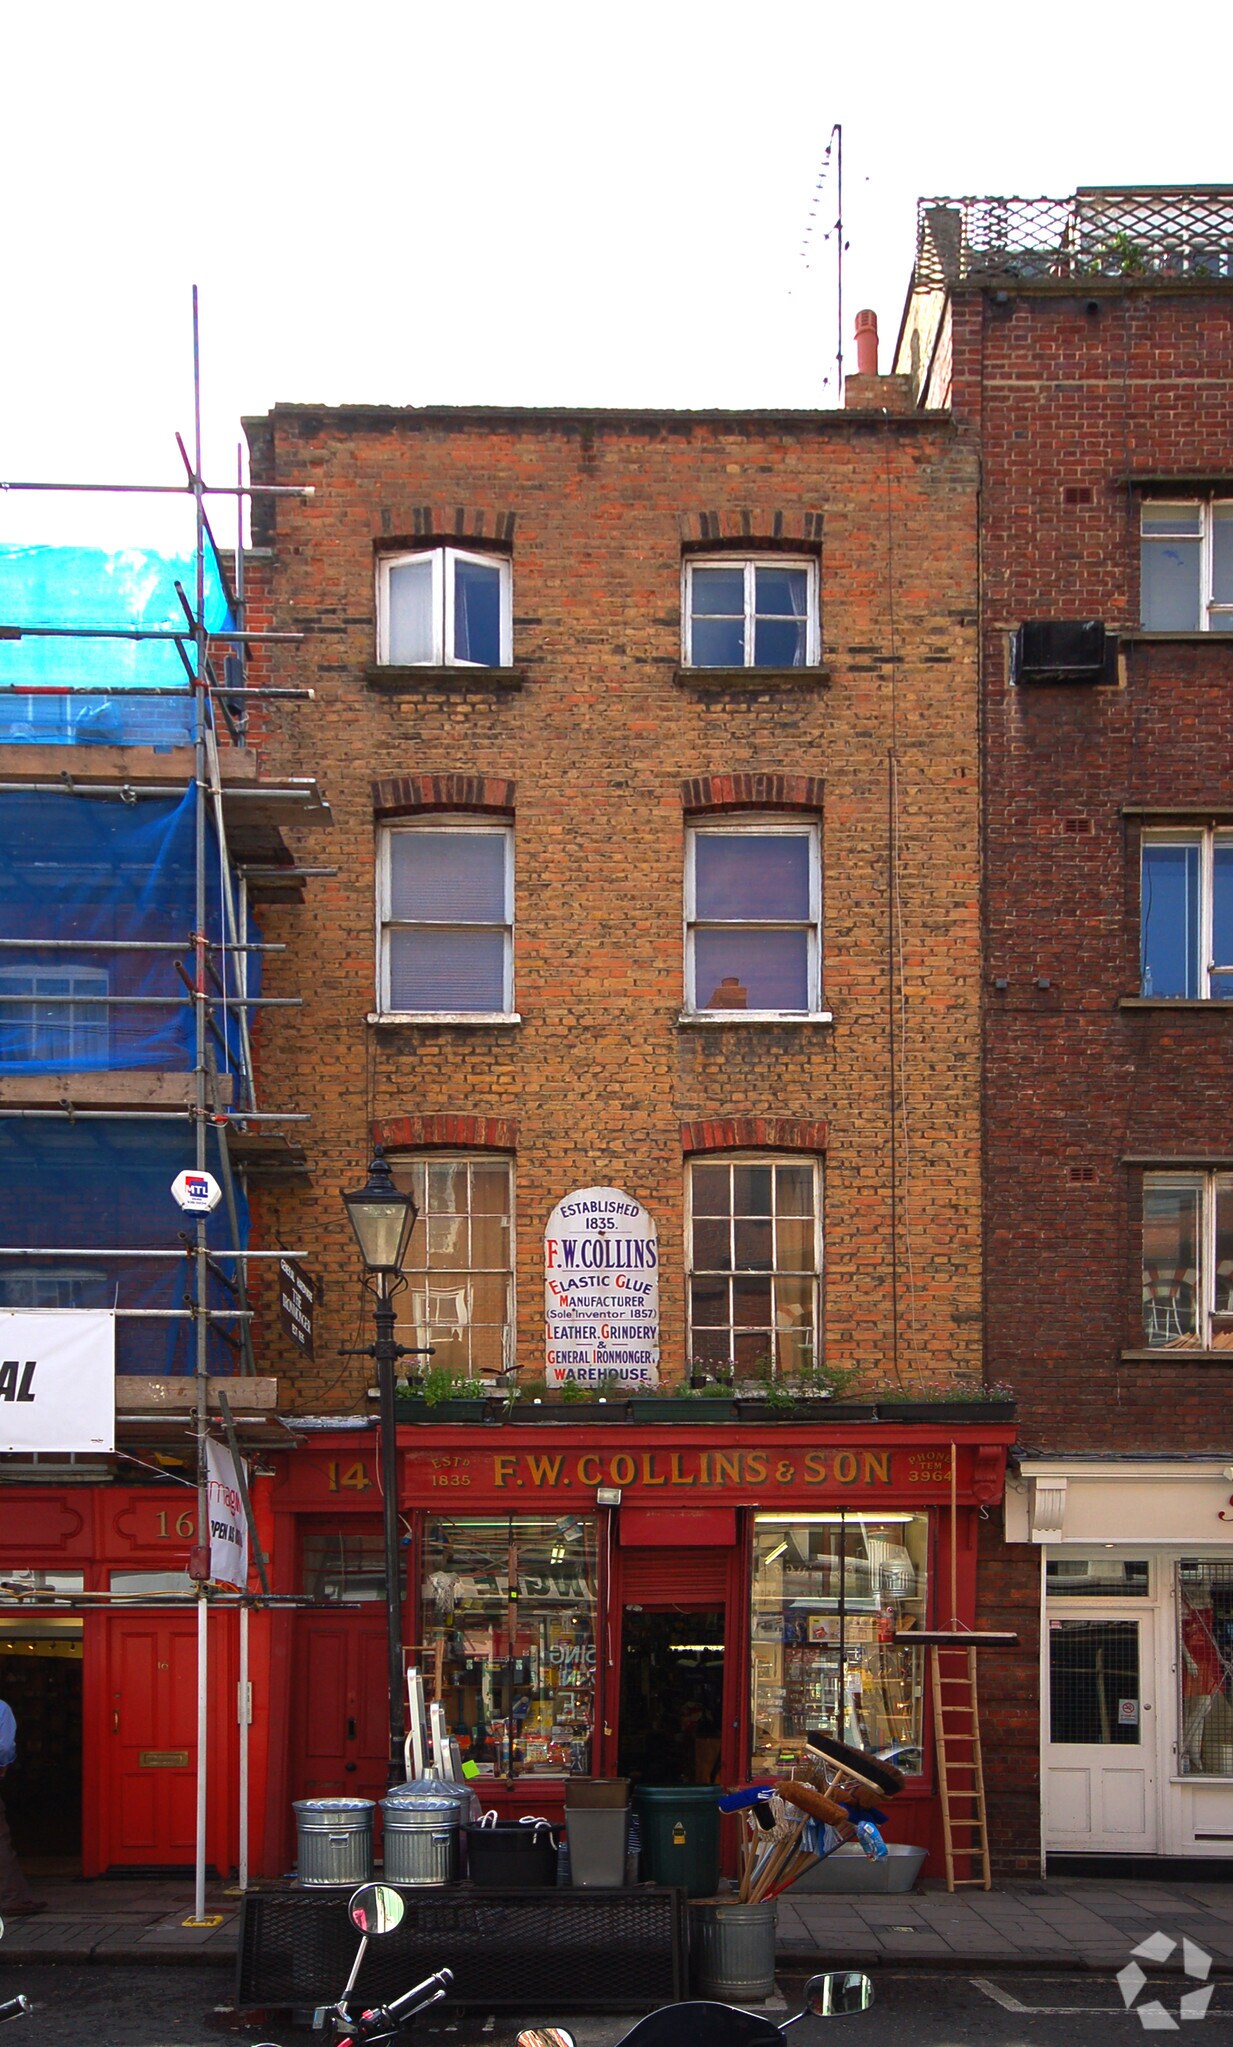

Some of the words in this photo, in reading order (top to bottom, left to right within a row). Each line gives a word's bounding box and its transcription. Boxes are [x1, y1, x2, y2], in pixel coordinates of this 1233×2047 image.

[560, 1201, 640, 1218] ESTABLISHED
[586, 1218, 618, 1229] 1835.
[548, 1276, 610, 1295] ELASTIC
[615, 1274, 653, 1295] GLUE
[560, 1295, 645, 1307] MANUFACTURER
[546, 1309, 572, 1319] (Sole
[575, 1309, 625, 1319] Inventor
[630, 1309, 657, 1319] 1857)
[597, 1341, 607, 1349] &
[547, 1349, 590, 1364] GENERAL
[592, 1350, 656, 1364] IRONMONGER
[908, 1452, 952, 1465] PHONE
[775, 1461, 795, 1482] &
[804, 1451, 891, 1483] SON
[919, 1462, 942, 1470] TEM
[328, 1461, 370, 1491] 14
[432, 1475, 471, 1487] 1835
[908, 1471, 952, 1483] 3964
[155, 1511, 195, 1539] 16
